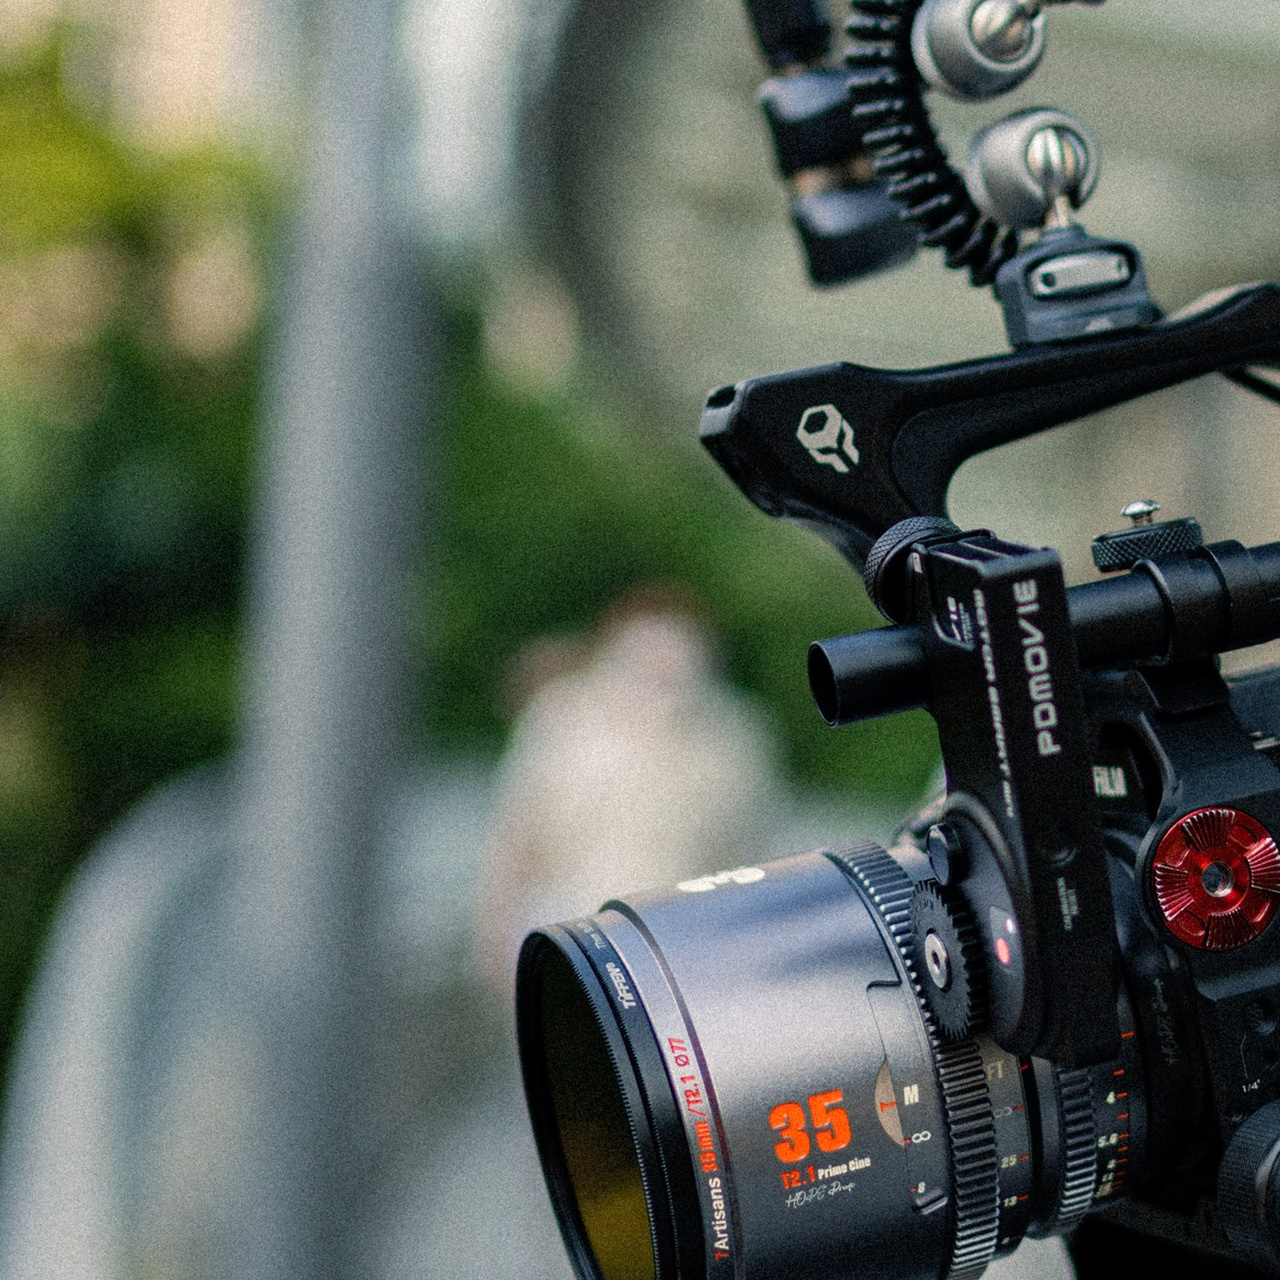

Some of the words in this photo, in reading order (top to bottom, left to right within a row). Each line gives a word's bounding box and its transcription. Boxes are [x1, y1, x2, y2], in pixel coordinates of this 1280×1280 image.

[1013, 579, 1061, 756] PDMOVIE
[904, 1084, 919, 1106] M
[768, 1089, 852, 1164] 35
[780, 1165, 816, 1189] T2.1
[817, 1163, 847, 1180] Prime
[848, 1156, 871, 1172] Cine
[1001, 1154, 1017, 1169] 25
